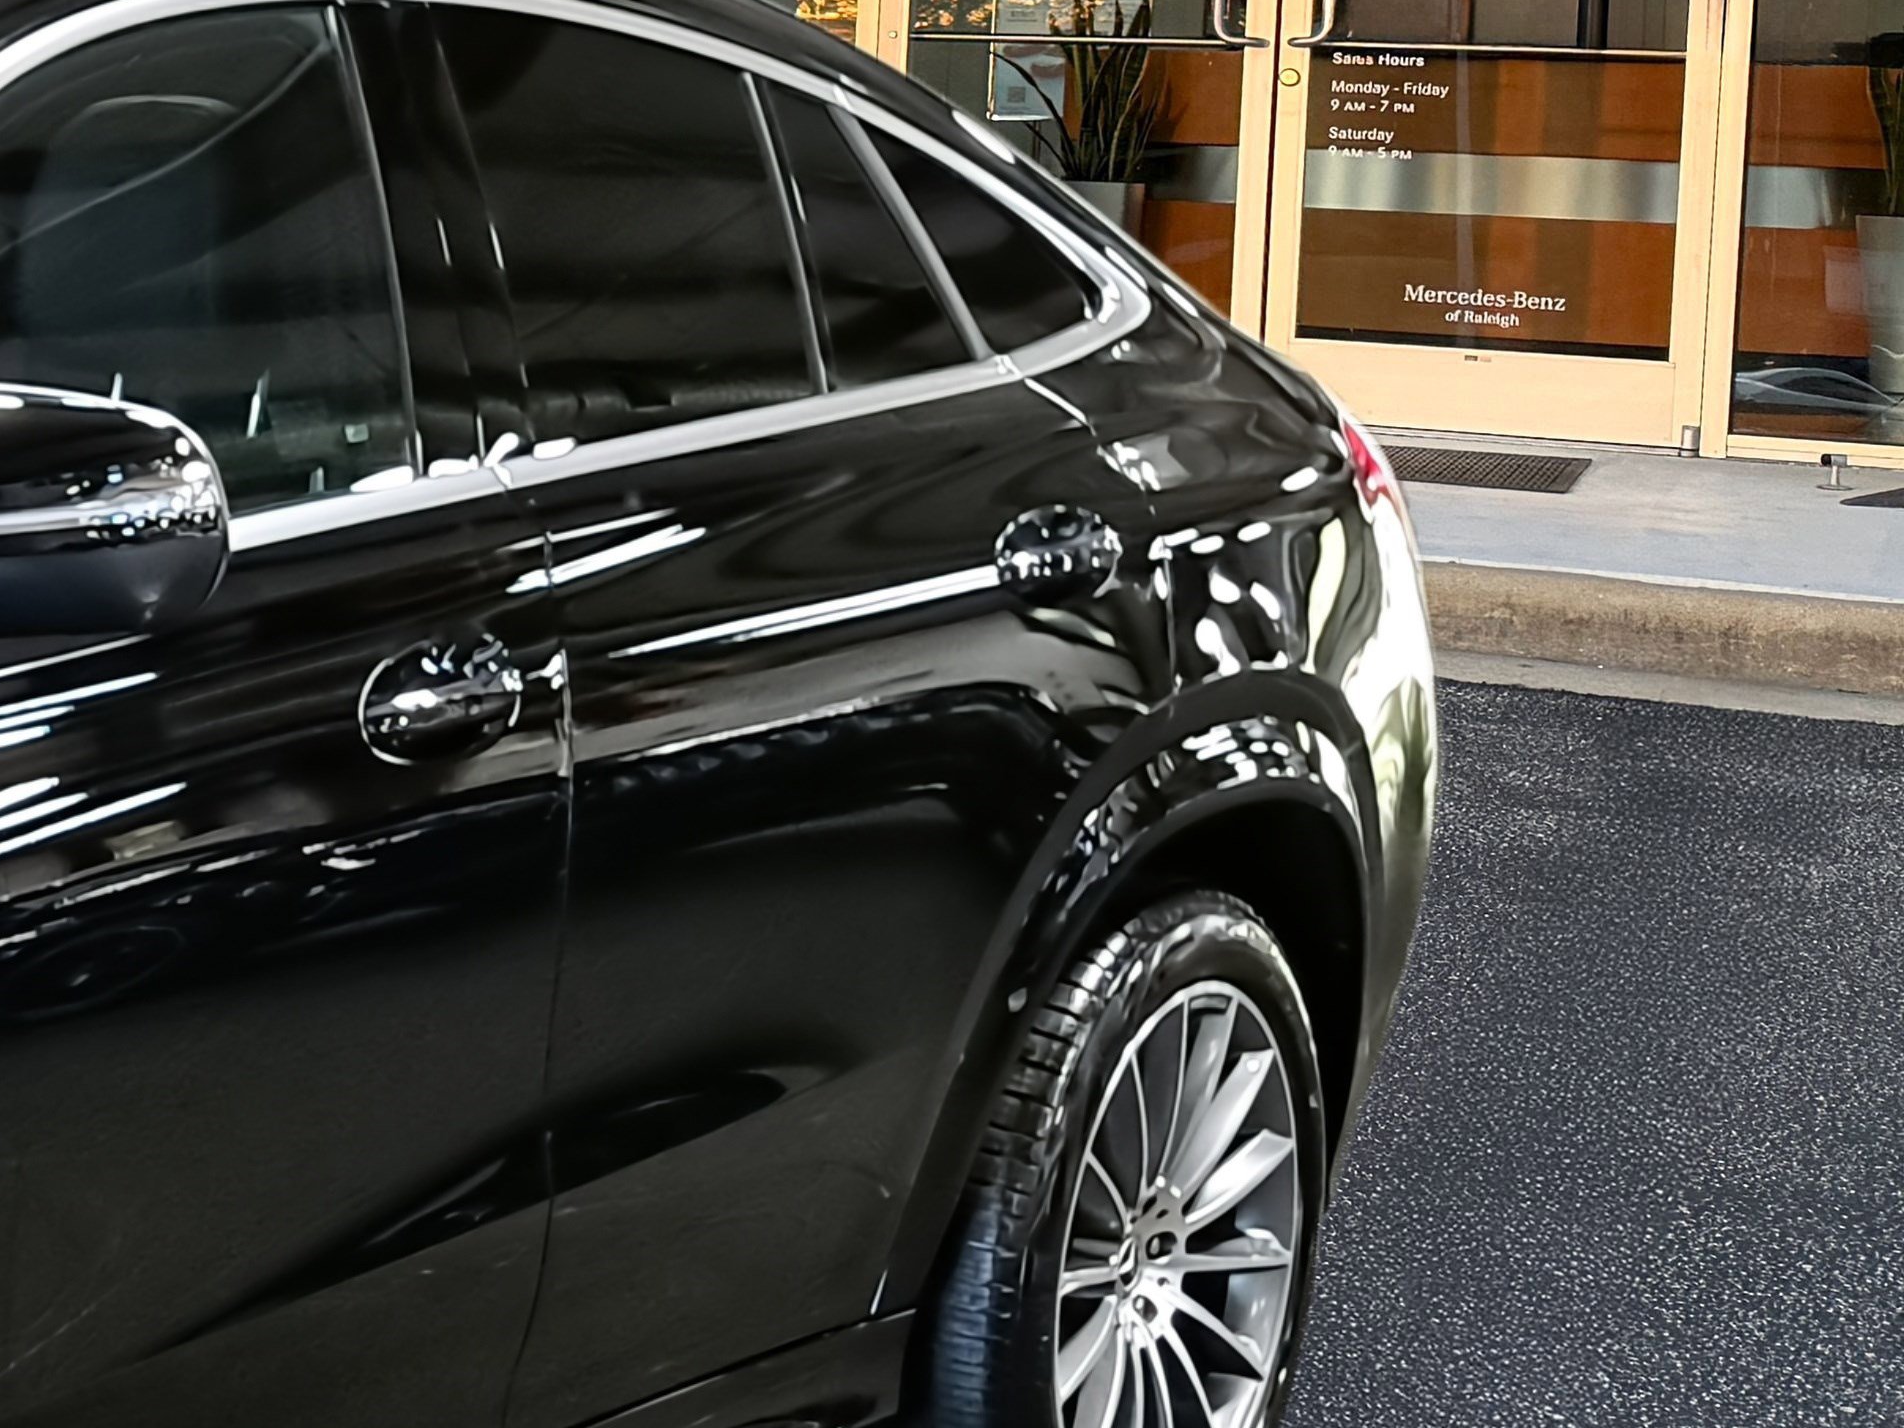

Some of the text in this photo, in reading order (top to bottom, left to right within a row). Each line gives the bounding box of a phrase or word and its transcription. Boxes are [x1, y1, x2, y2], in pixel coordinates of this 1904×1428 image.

[1378, 53, 1425, 67] Hours
[1330, 79, 1391, 97] Monday
[1403, 81, 1450, 98] Friday
[1330, 98, 1340, 111] 9
[1343, 101, 1366, 112] AM
[1380, 100, 1390, 112] 7
[1393, 102, 1415, 114] PM
[1328, 126, 1394, 143] Saturday
[1327, 144, 1337, 157] 9
[1341, 148, 1364, 158] AM
[1377, 146, 1387, 158] 5
[1391, 149, 1413, 160] PM
[1403, 283, 1566, 312] Mercedes-Benz
[1444, 309, 1520, 329] of Raleigh
